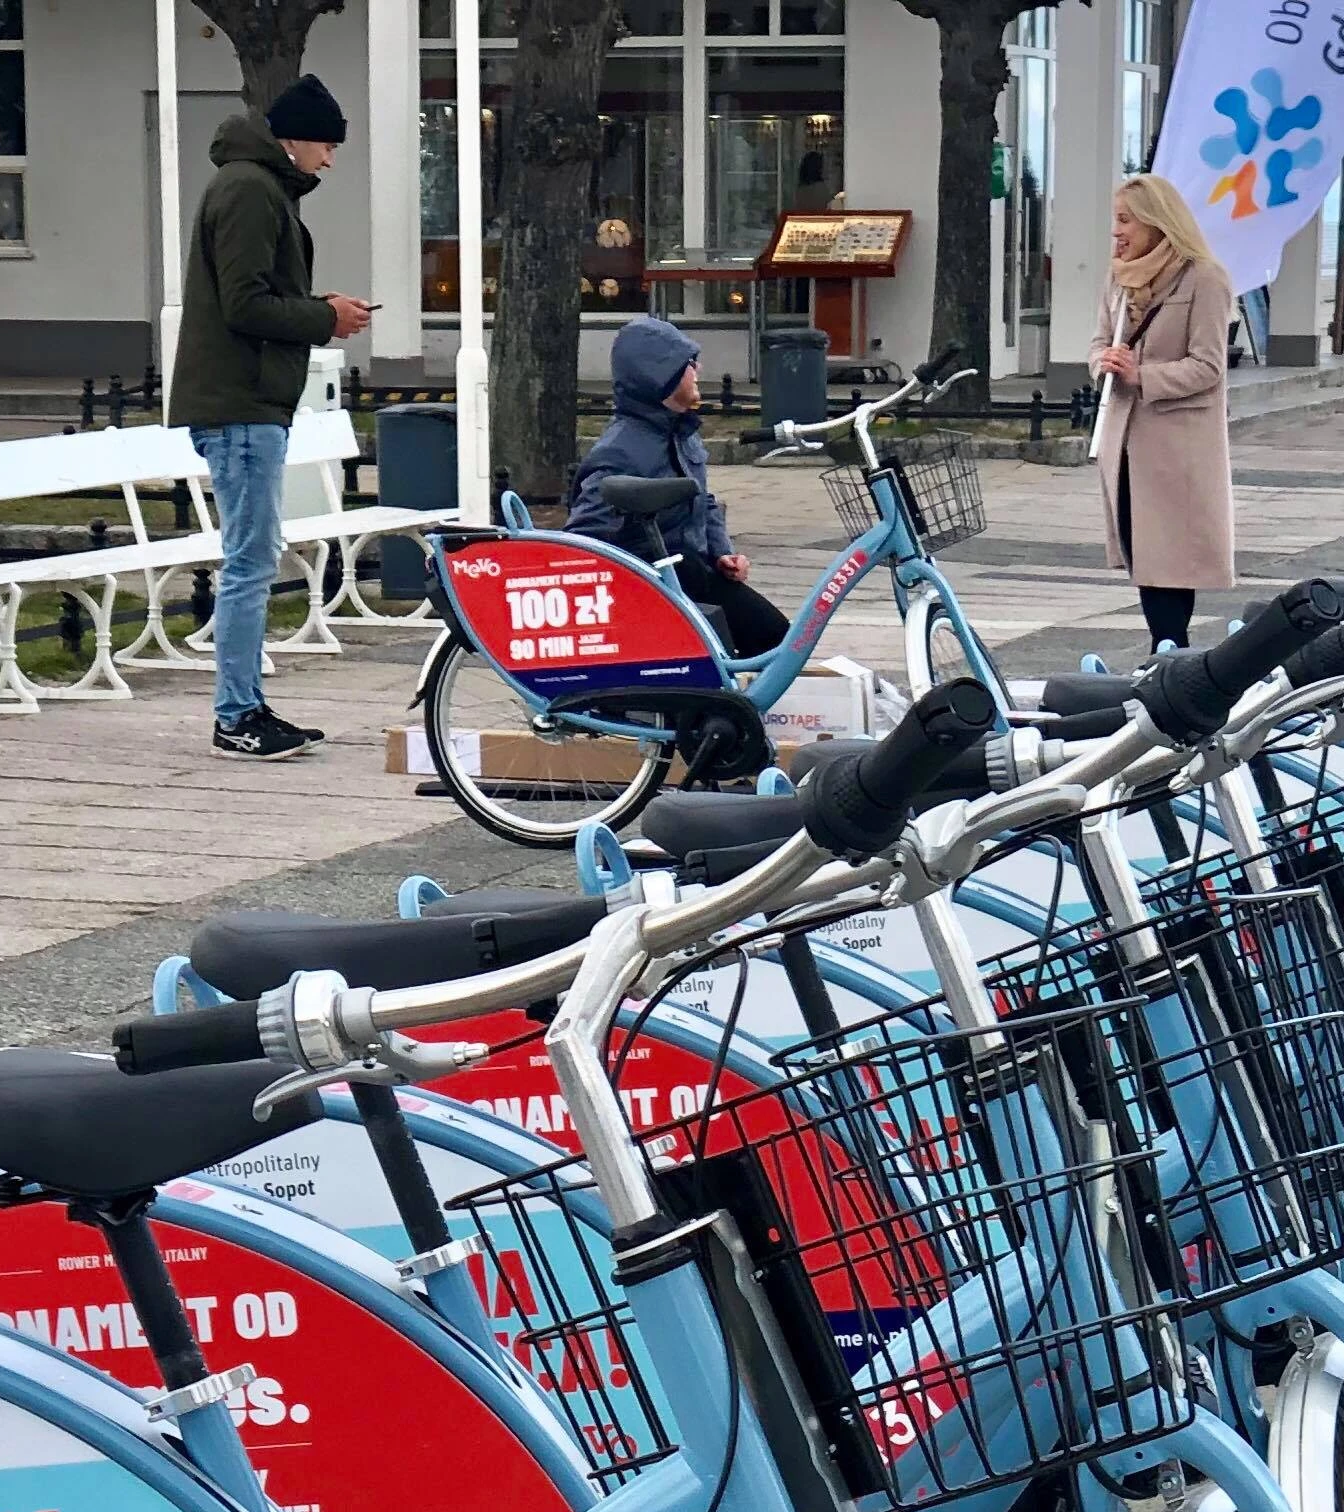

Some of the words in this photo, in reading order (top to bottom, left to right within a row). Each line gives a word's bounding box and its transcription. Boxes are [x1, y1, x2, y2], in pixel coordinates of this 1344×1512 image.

[505, 587, 569, 630] 100
[574, 584, 615, 626] zł
[509, 638, 536, 660] 90
[538, 635, 575, 659] MIN
[263, 1179, 316, 1201] Sopot
[57, 1255, 101, 1271] ROWER
[232, 1290, 299, 1340] OD
